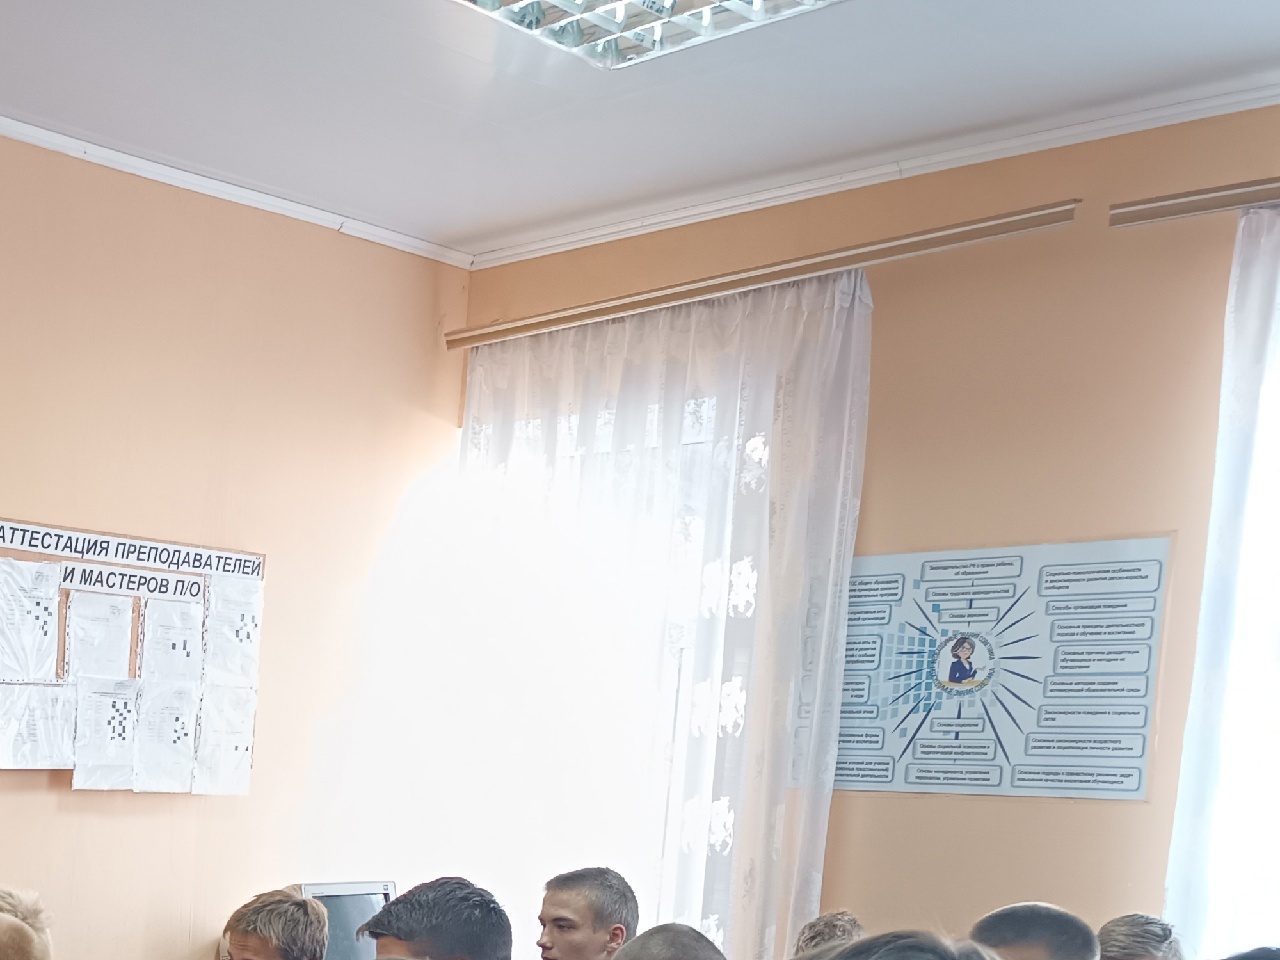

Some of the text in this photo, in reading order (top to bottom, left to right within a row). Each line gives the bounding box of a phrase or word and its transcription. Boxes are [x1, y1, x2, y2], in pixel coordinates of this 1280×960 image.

[115, 542, 261, 577] ПРЕПОДАВАТЕЛЕЙ
[62, 566, 75, 584] И
[79, 568, 169, 595] МАСТЕРОВ
[172, 579, 201, 598] П/О
